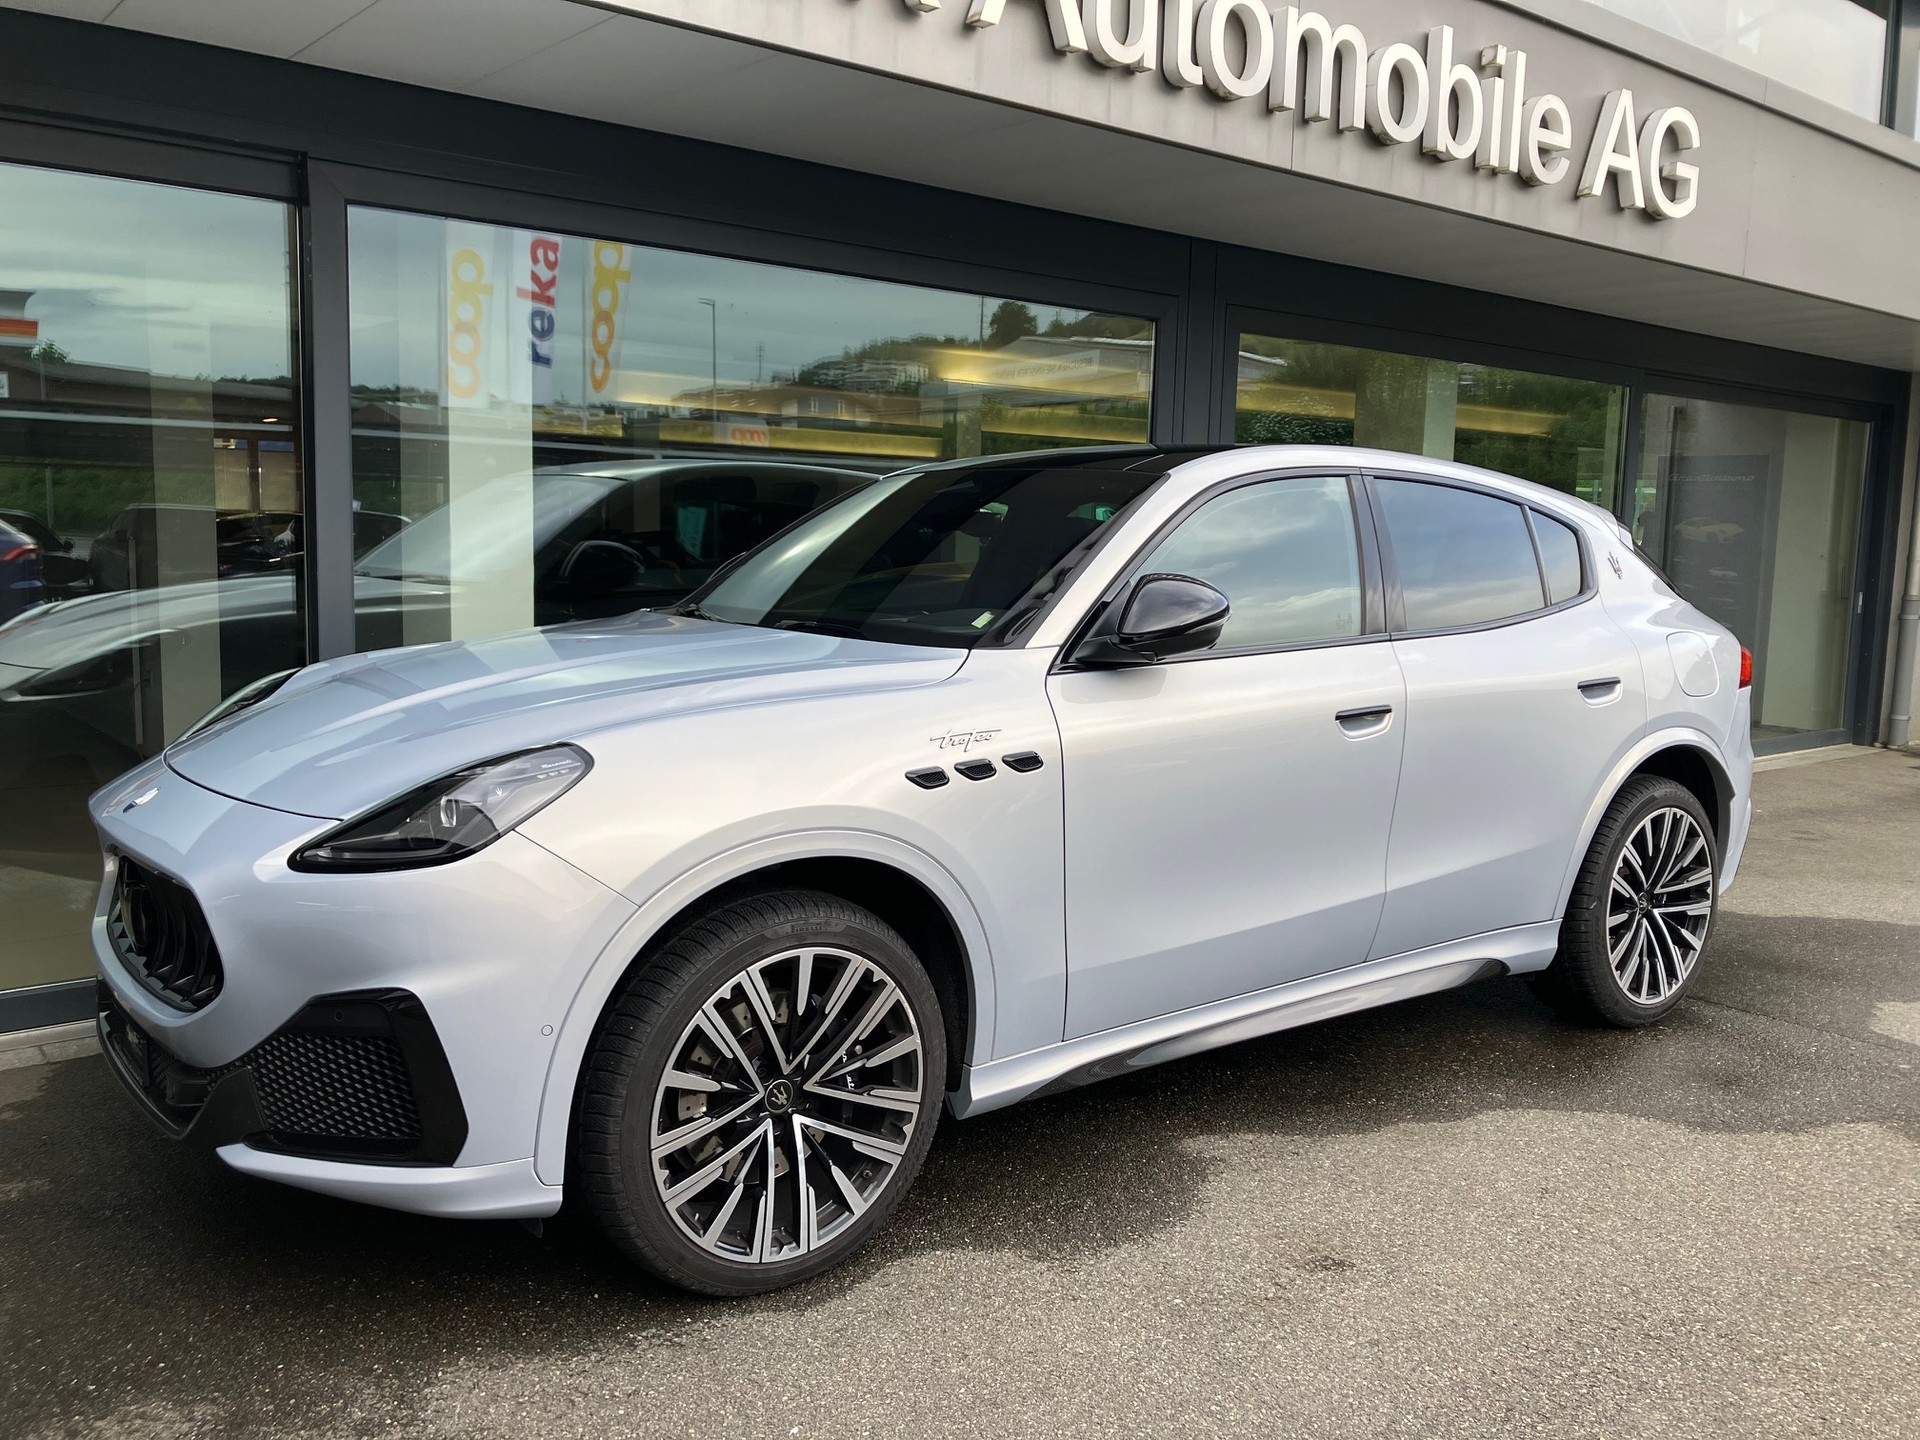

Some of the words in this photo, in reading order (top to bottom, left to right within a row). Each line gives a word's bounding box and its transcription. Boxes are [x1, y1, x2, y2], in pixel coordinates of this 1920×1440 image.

[1576, 88, 1701, 221] AG
[447, 248, 494, 399] coop
[516, 237, 561, 369] reka
[590, 239, 632, 393] coop
